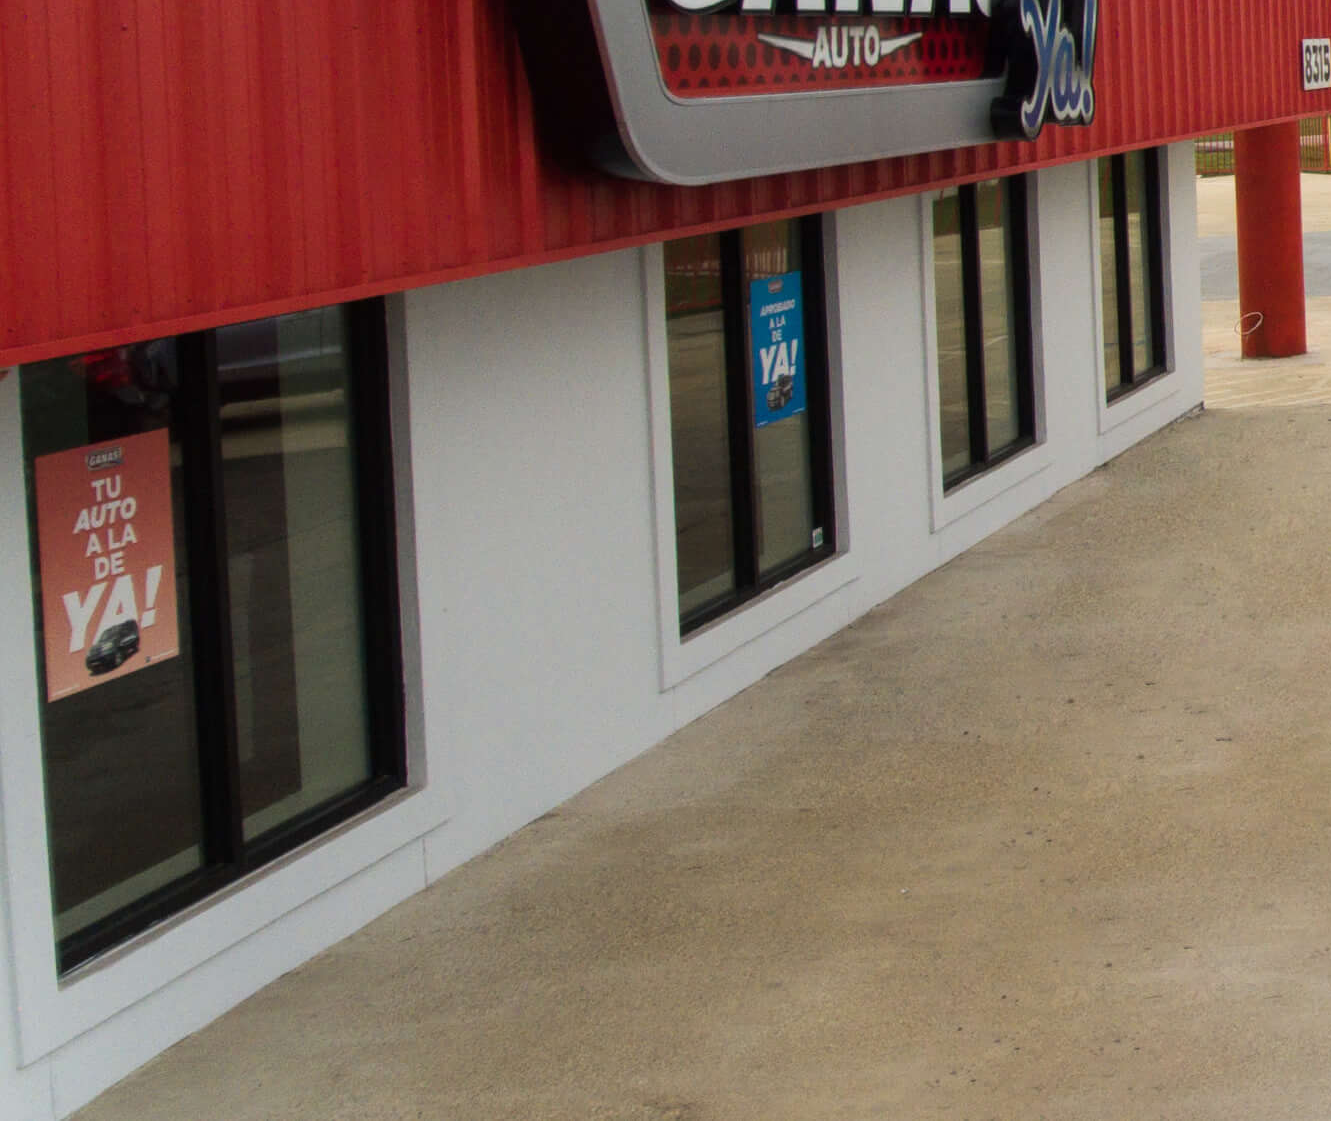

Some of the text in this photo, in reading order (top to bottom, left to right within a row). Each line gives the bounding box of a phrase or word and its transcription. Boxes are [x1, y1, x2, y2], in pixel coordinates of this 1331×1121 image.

[812, 25, 881, 68] AUTO
[1304, 44, 1331, 84] 8315
[768, 314, 786, 329] A LA
[771, 329, 782, 343] DE
[759, 338, 799, 385] YA!
[90, 474, 122, 502] TU
[73, 496, 137, 535] AUTO
[85, 523, 137, 557] A LA
[94, 550, 125, 581] DE
[62, 564, 163, 653] YA!
